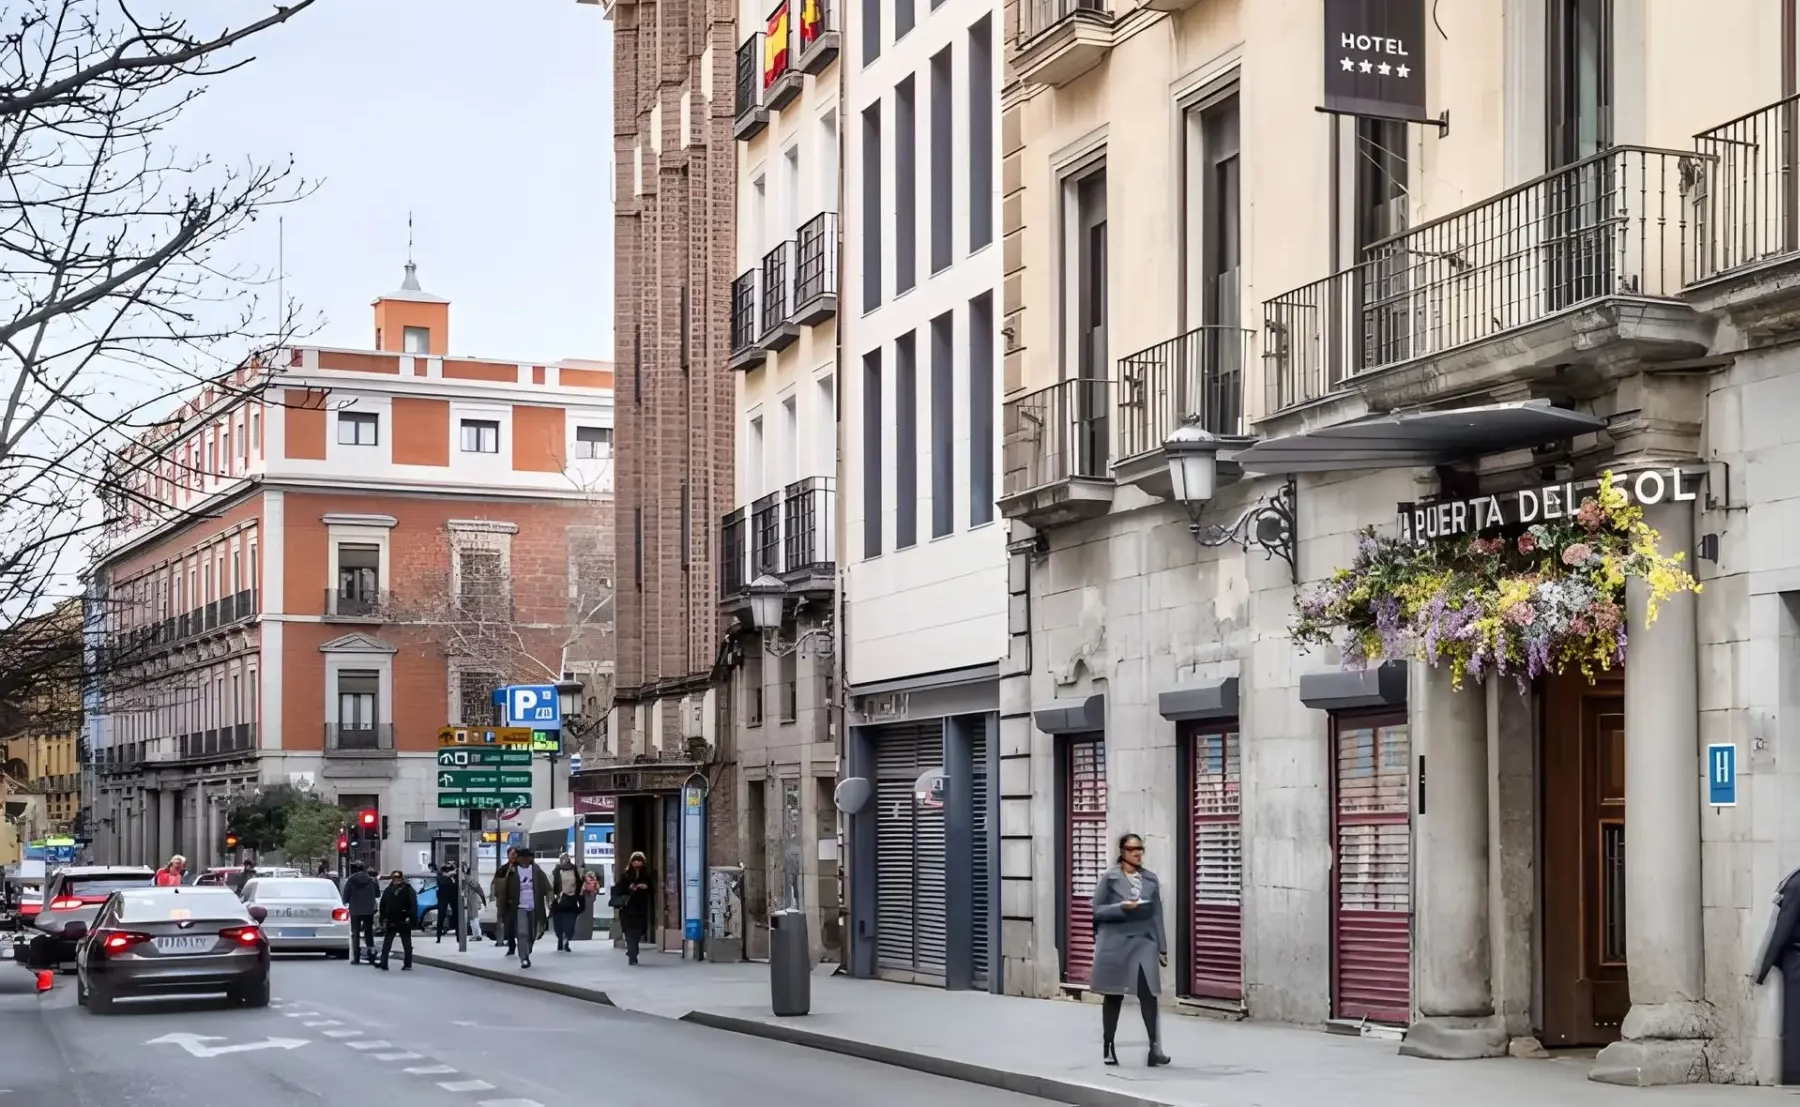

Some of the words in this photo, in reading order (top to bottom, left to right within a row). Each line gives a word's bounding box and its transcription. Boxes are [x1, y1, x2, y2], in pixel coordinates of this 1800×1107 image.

[1341, 32, 1408, 56] HOTEL
[1415, 494, 1504, 546] PUERTA
[1519, 482, 1580, 523] DEL
[515, 690, 537, 720] P
[1716, 751, 1728, 783] H
